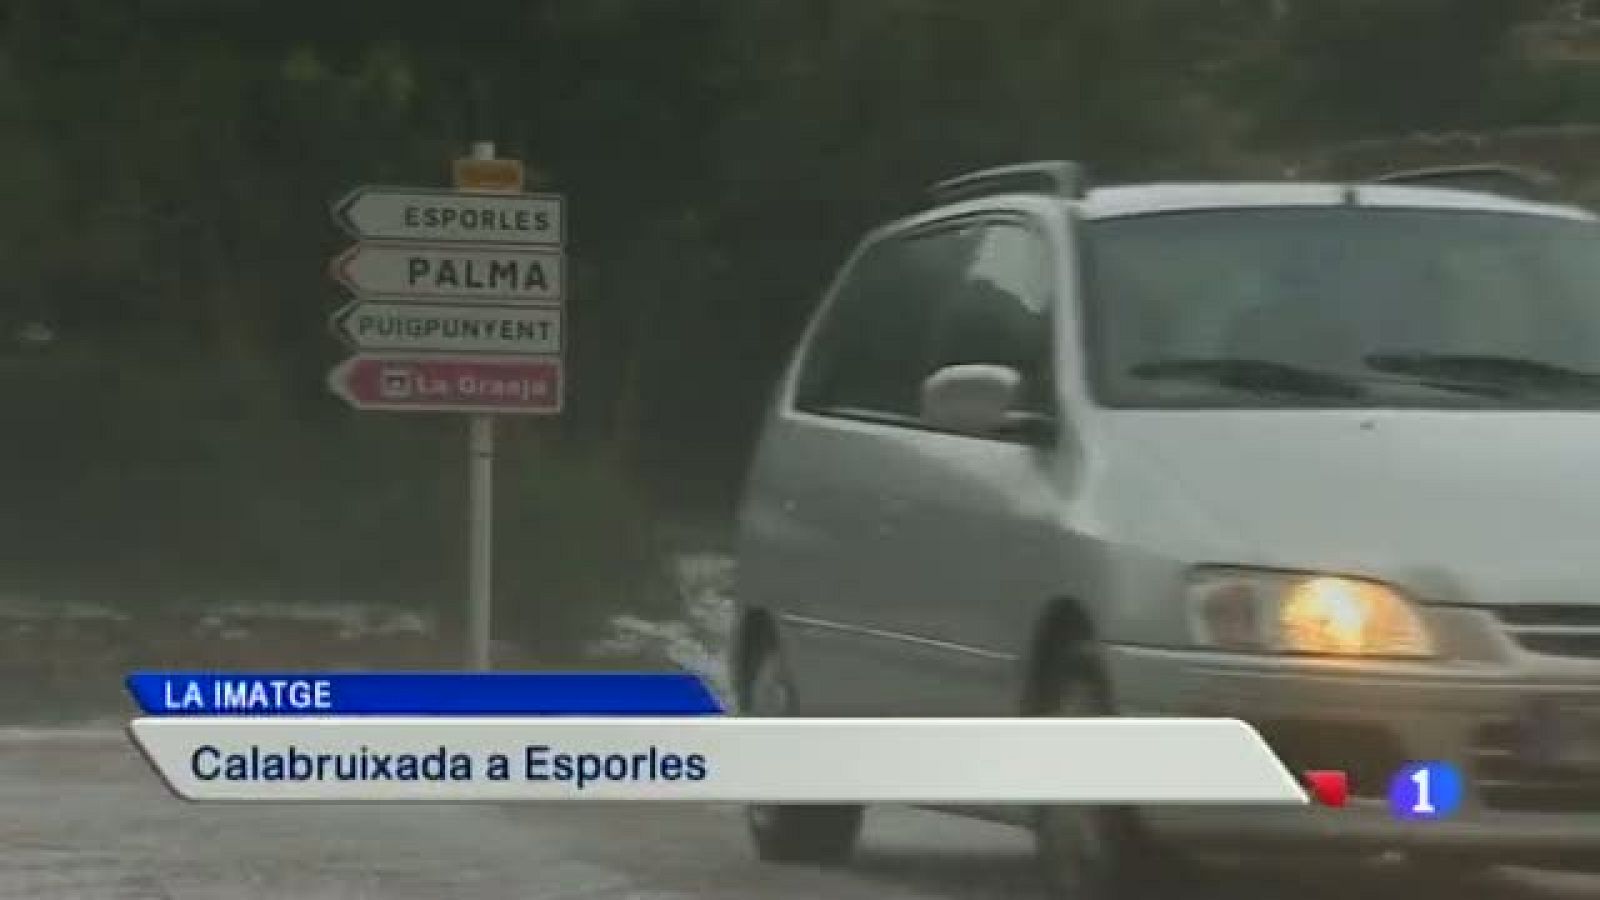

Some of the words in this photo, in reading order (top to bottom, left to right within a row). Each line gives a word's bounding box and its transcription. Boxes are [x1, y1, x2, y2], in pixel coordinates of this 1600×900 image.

[404, 206, 551, 231] ESPORLES
[408, 257, 550, 291] PALMA
[359, 314, 552, 341] PUIGPUNYENT
